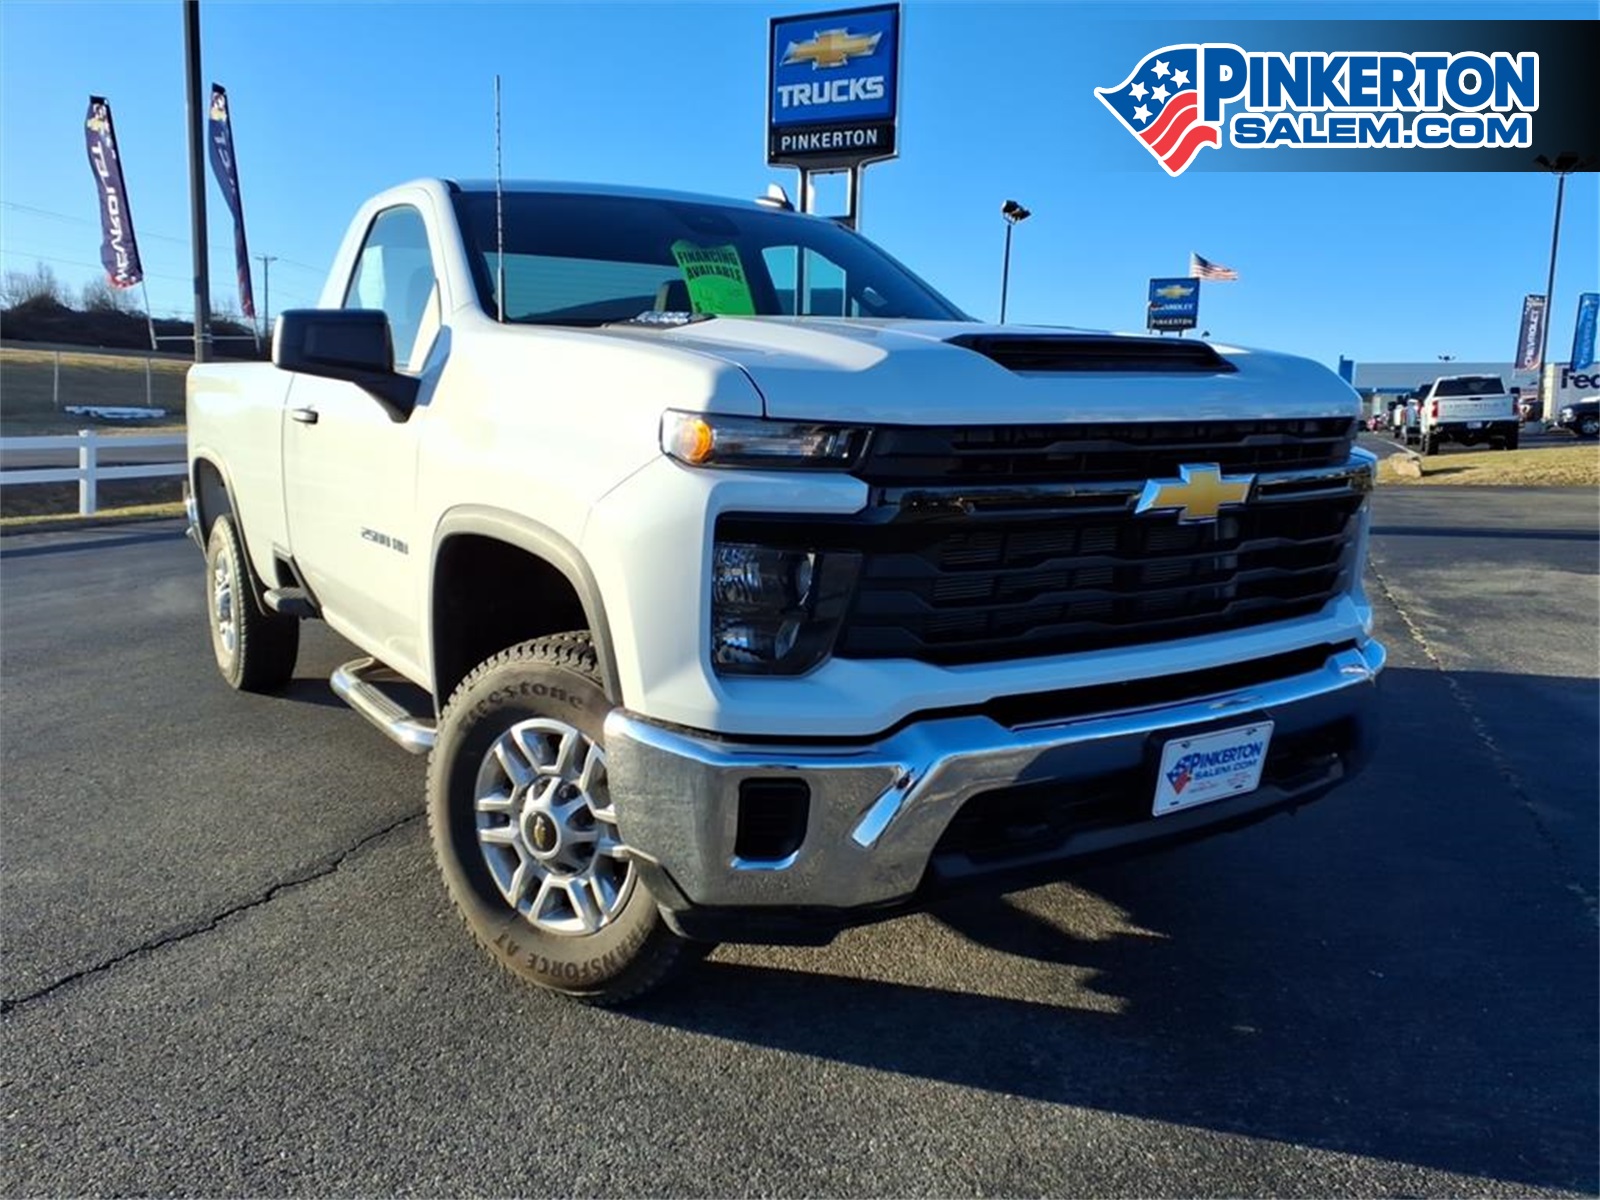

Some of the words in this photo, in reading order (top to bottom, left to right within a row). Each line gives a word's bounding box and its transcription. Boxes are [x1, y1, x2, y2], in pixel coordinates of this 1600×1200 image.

[777, 75, 885, 108] TRUCKS
[781, 129, 878, 151] PINKERTON
[677, 248, 739, 266] FINANCING
[686, 264, 743, 283] AVAILABLE
[1188, 741, 1263, 774] PINKERTON
[1194, 759, 1258, 780] SALEM.COM
[492, 932, 521, 958] AT
[524, 923, 649, 982] TRANSFORCE
